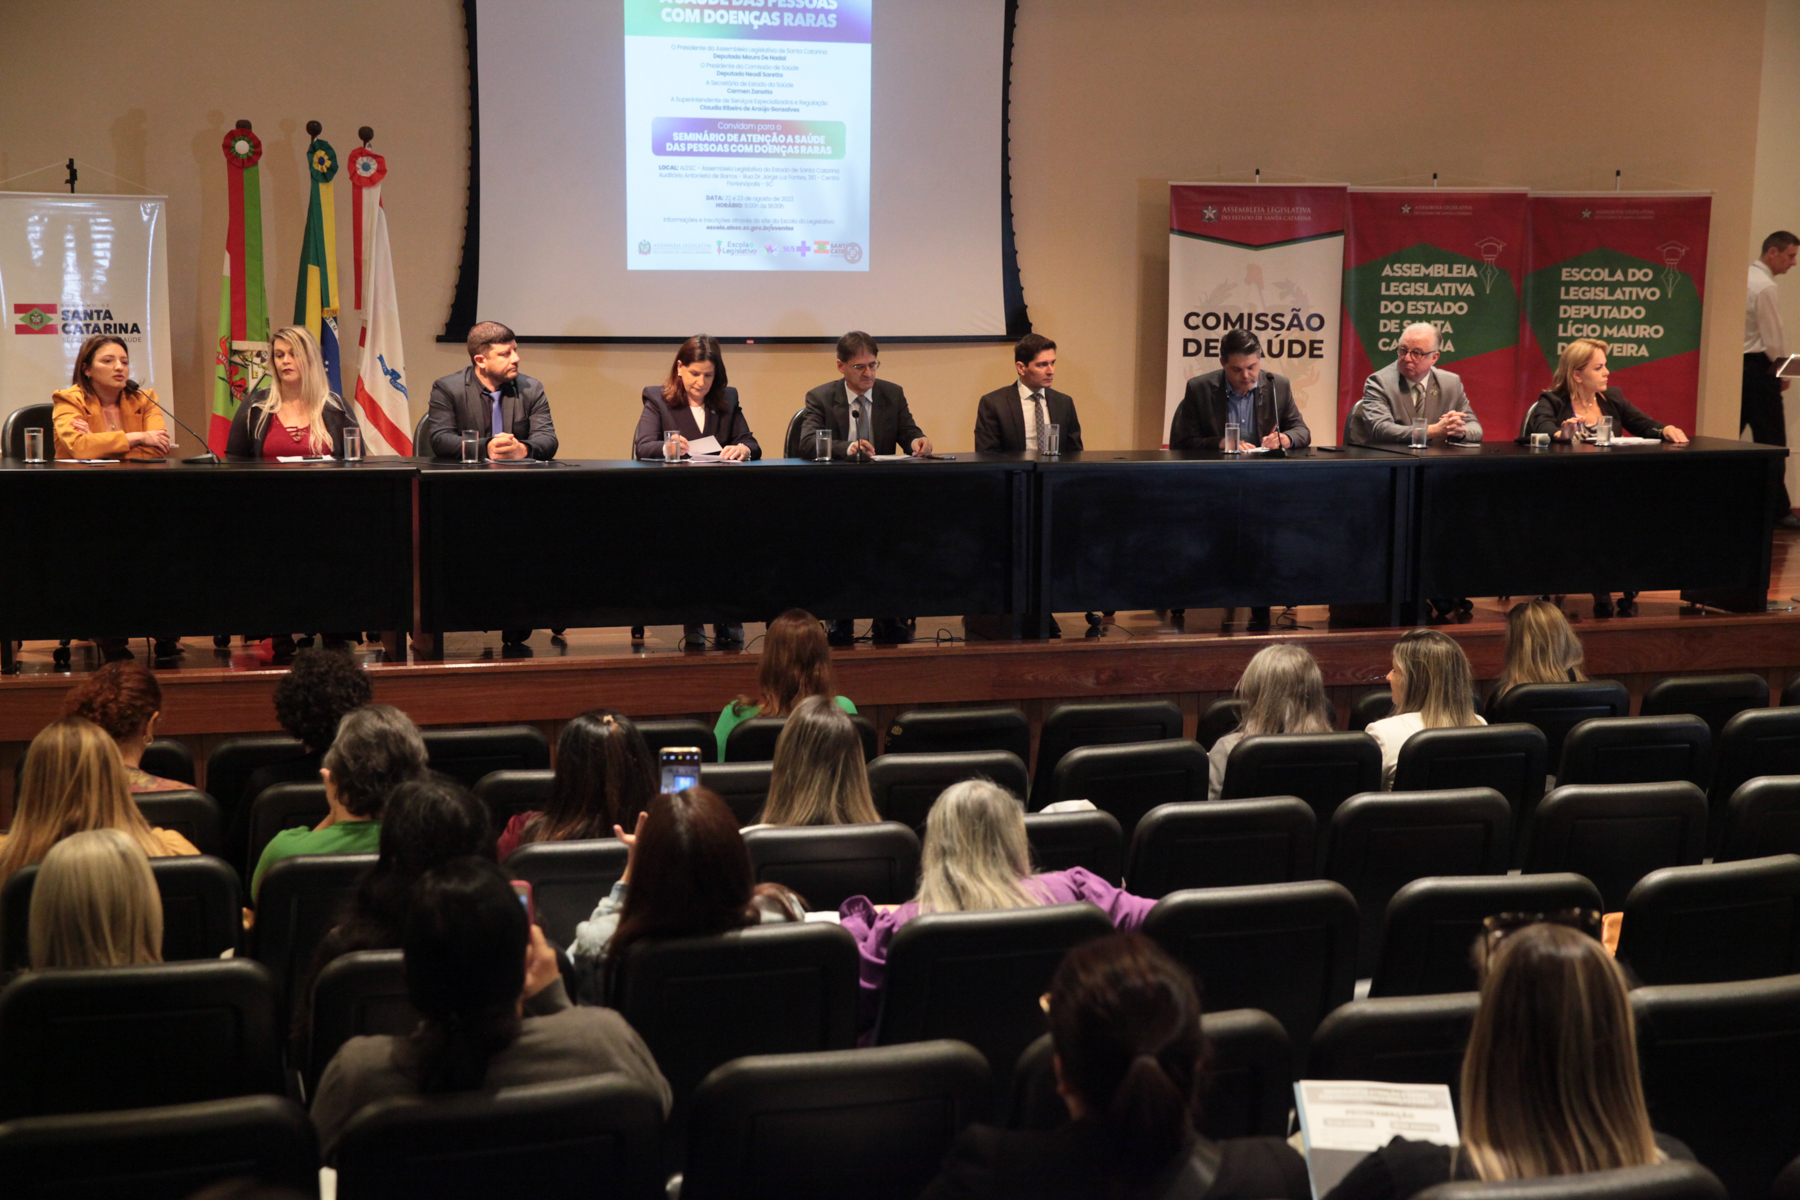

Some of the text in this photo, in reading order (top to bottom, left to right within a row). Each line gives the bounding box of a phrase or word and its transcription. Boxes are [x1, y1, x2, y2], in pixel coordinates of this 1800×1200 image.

[661, 8, 837, 29] COM DOENÇAS RARAS
[718, 122, 756, 130] Convidam
[758, 124, 775, 132] para
[673, 131, 825, 146] SEMINÁRIO DE ATENÇÃO A SAÚDE
[666, 143, 832, 156] DAS PESSOAS COM DOENÇAS RARAS
[723, 247, 757, 255] Legislativo
[1382, 264, 1478, 277] ASSEMBLEIA
[1561, 268, 1653, 282] ESCOLA DO
[1381, 282, 1475, 296] LEGISLATIVA
[1560, 287, 1660, 300] LEGISLATIVO
[62, 309, 113, 321] SANTA
[1380, 301, 1468, 315] DO ESTADO
[1559, 305, 1646, 319] DEPUTADO
[1183, 308, 1325, 332] COMISSÃO
[1379, 319, 1453, 333] DE STA
[62, 323, 141, 334] CATARINA
[1558, 320, 1664, 338] LÍCIO MAURO
[1182, 334, 1324, 358] DE ÚDE
[1557, 342, 1649, 356] D VEIRA
